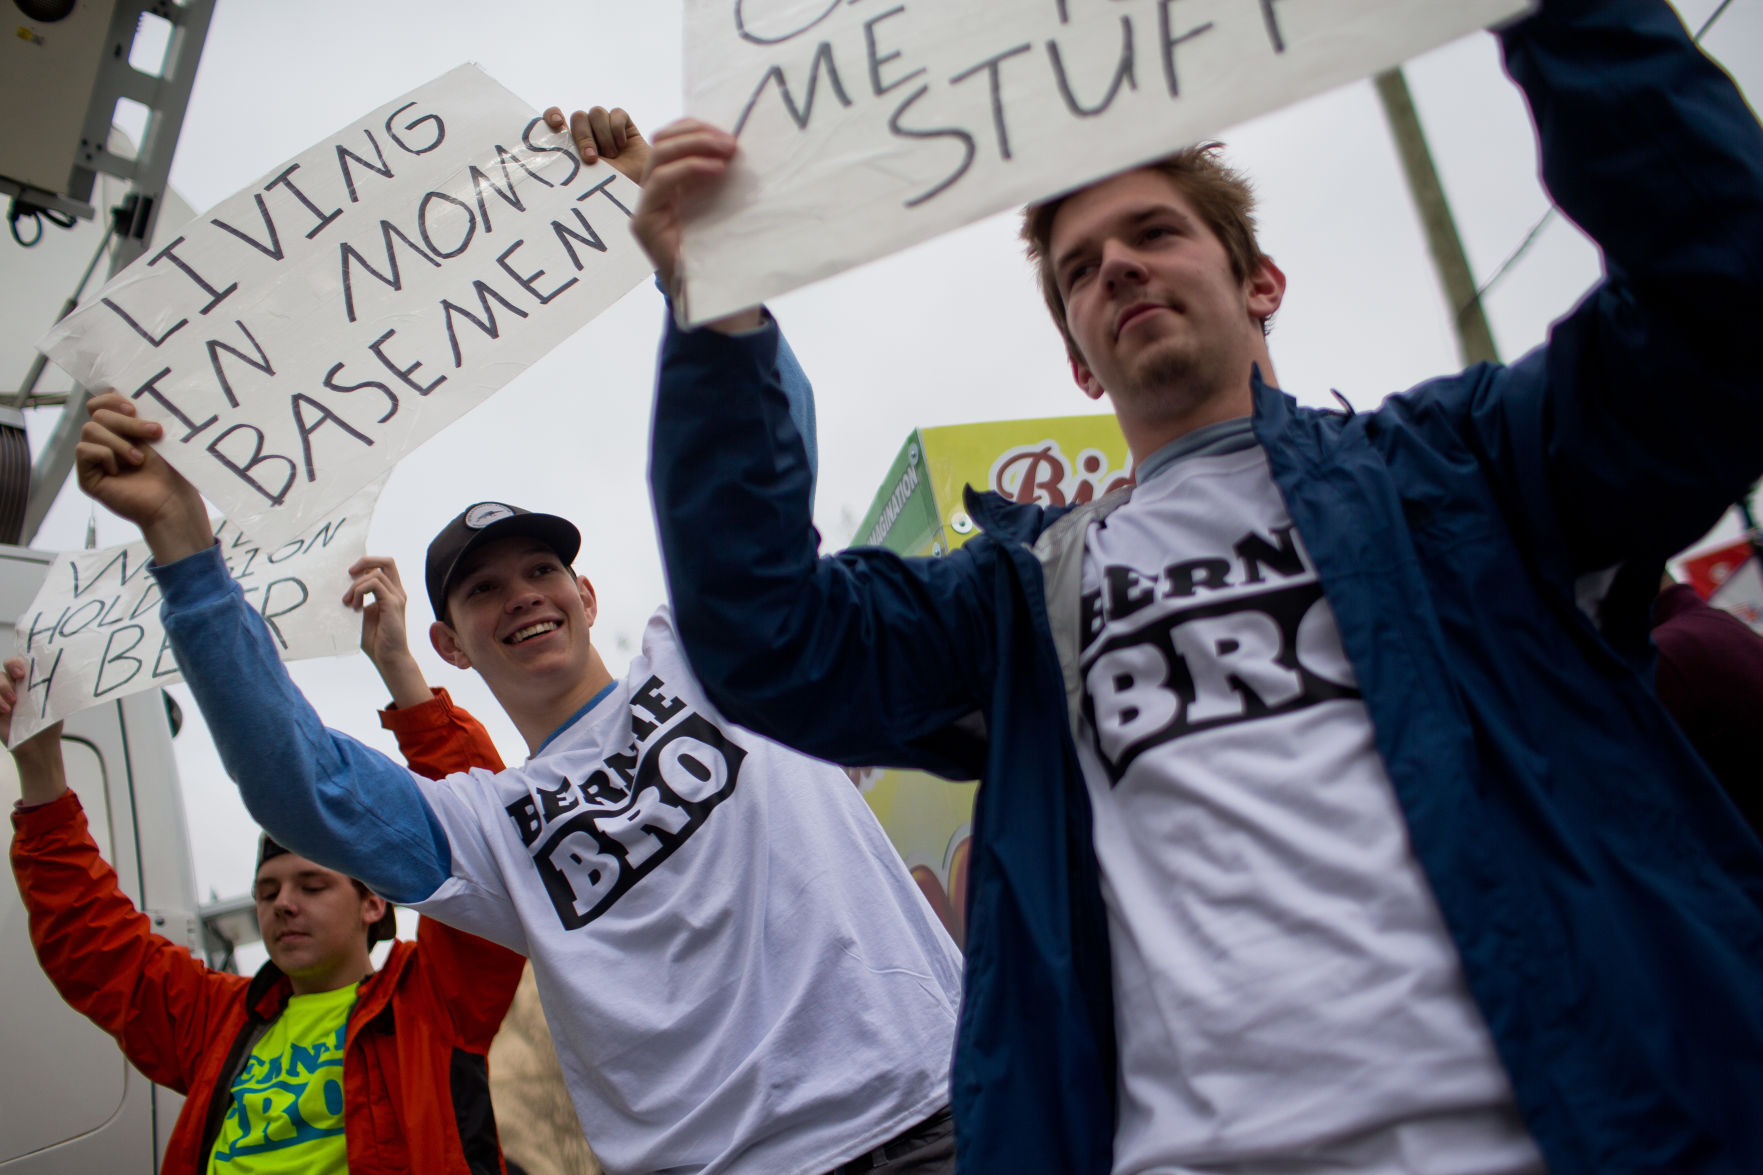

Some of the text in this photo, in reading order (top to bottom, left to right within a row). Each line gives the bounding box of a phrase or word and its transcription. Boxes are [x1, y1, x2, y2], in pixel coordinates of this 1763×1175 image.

[734, 5, 928, 136] ME
[101, 101, 446, 348] LIVING
[132, 116, 582, 443] IN MOMS
[206, 174, 636, 507] BASEMENT
[27, 582, 166, 654] HOLD
[27, 576, 309, 720] 4 BER
[505, 674, 688, 849] BERNIE
[549, 736, 729, 918] BRO
